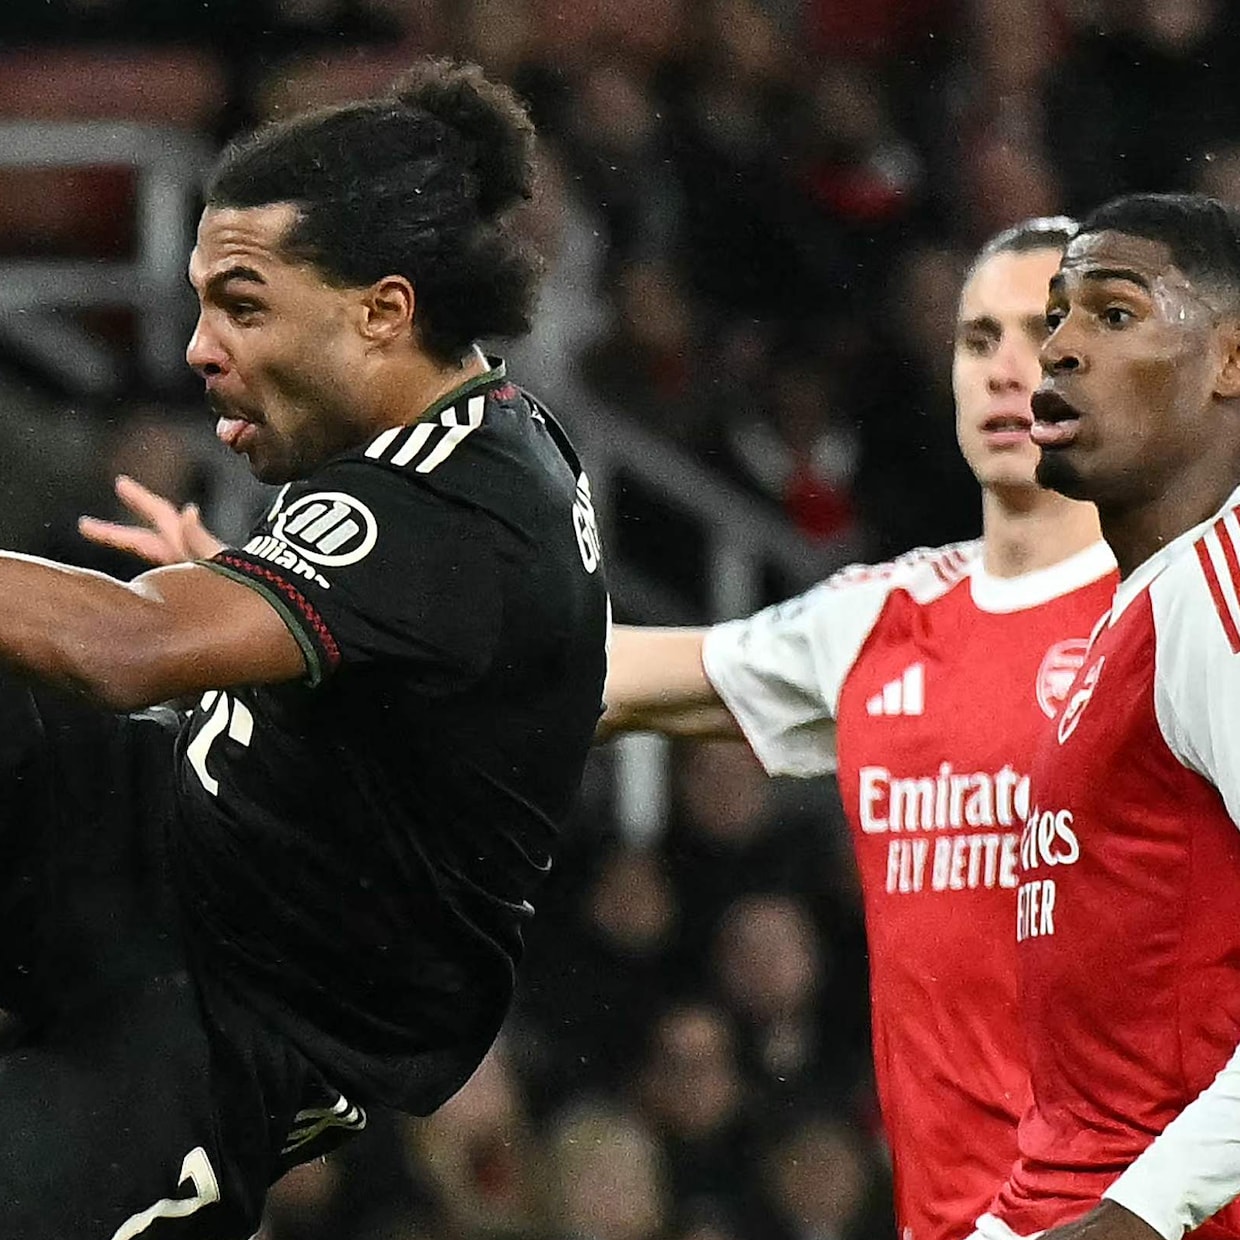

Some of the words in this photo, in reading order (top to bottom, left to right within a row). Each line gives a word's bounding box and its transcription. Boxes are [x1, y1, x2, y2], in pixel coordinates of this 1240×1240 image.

[859, 762, 1031, 833] Emirat
[886, 838, 929, 893] FLY
[931, 833, 1020, 890] BETTE
